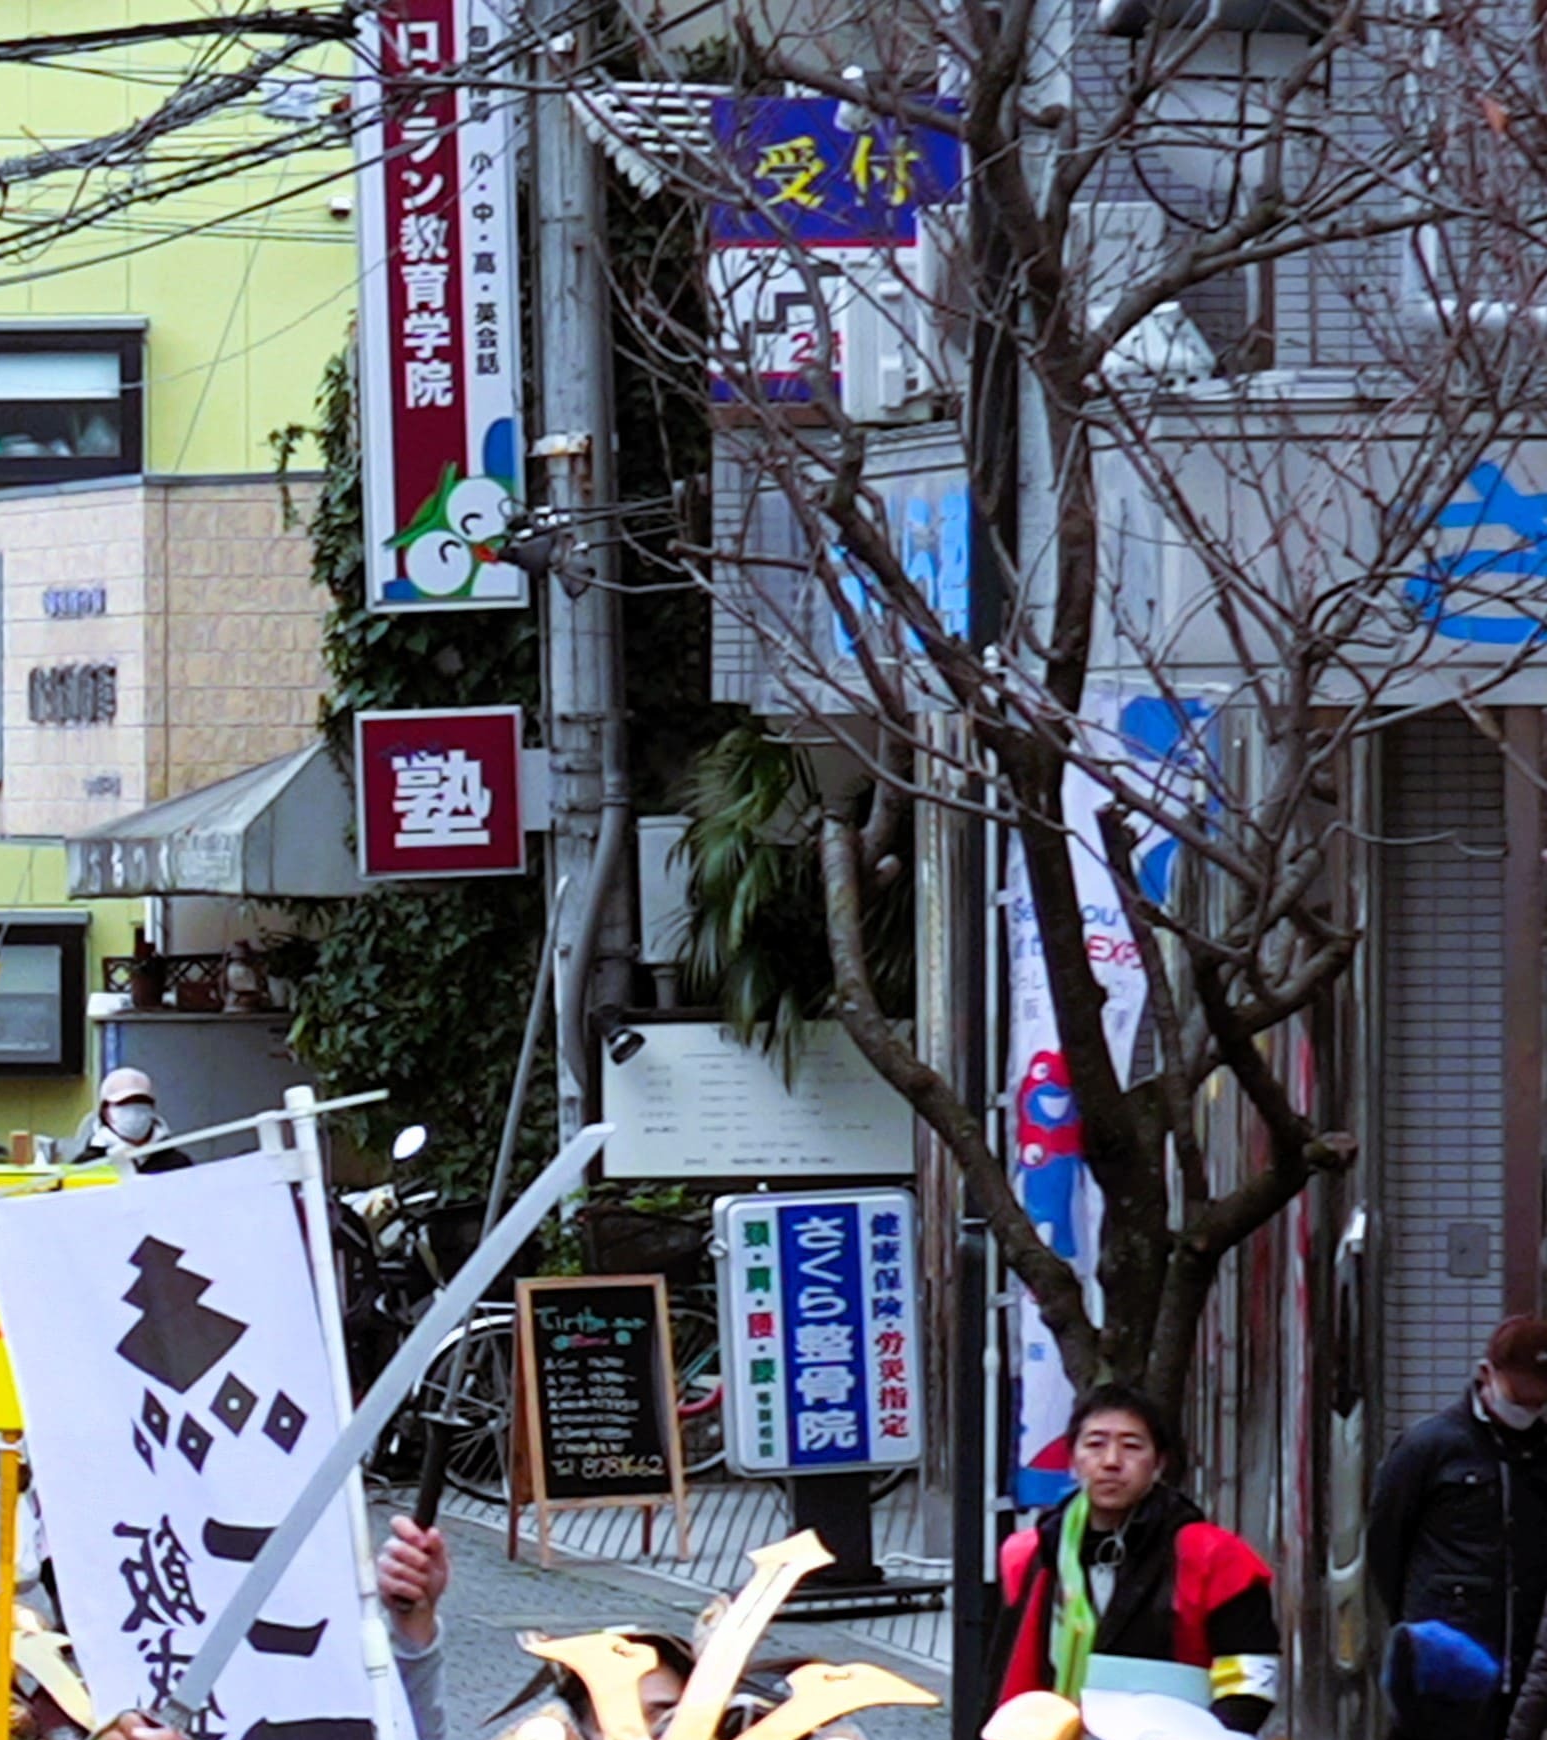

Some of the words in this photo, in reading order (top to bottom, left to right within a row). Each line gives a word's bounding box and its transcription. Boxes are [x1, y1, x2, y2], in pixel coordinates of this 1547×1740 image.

[397, 20, 457, 409] ロラン教育学院
[753, 134, 919, 208] 受付
[391, 748, 492, 849] 塾
[792, 1215, 858, 1452] さくら整骨院
